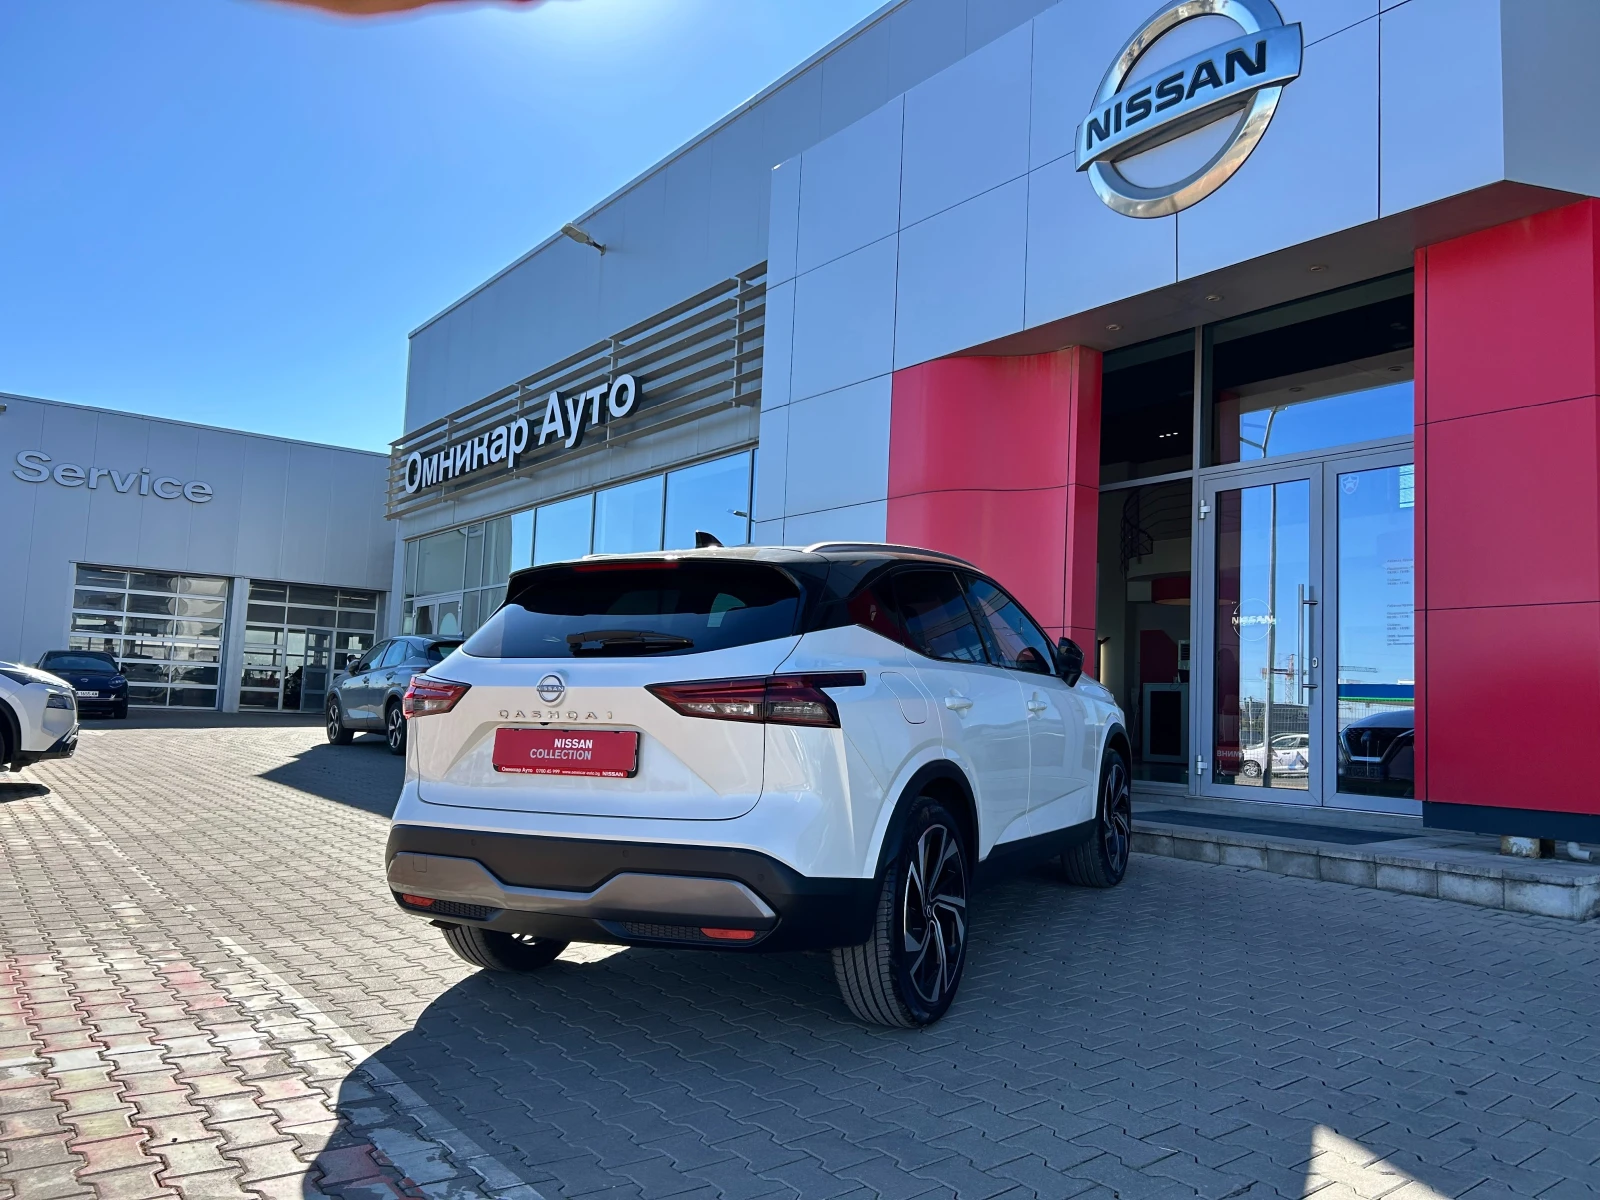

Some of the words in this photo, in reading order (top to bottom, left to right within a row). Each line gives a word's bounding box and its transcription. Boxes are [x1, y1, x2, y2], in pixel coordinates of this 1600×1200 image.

[1086, 39, 1267, 152] NISSAN
[404, 417, 530, 494] Омникар
[538, 373, 638, 449] Ауто
[13, 449, 214, 504] Service
[498, 709, 613, 721] QASHQAI
[529, 748, 592, 761] COLLECTION
[554, 738, 593, 749] NISSAN
